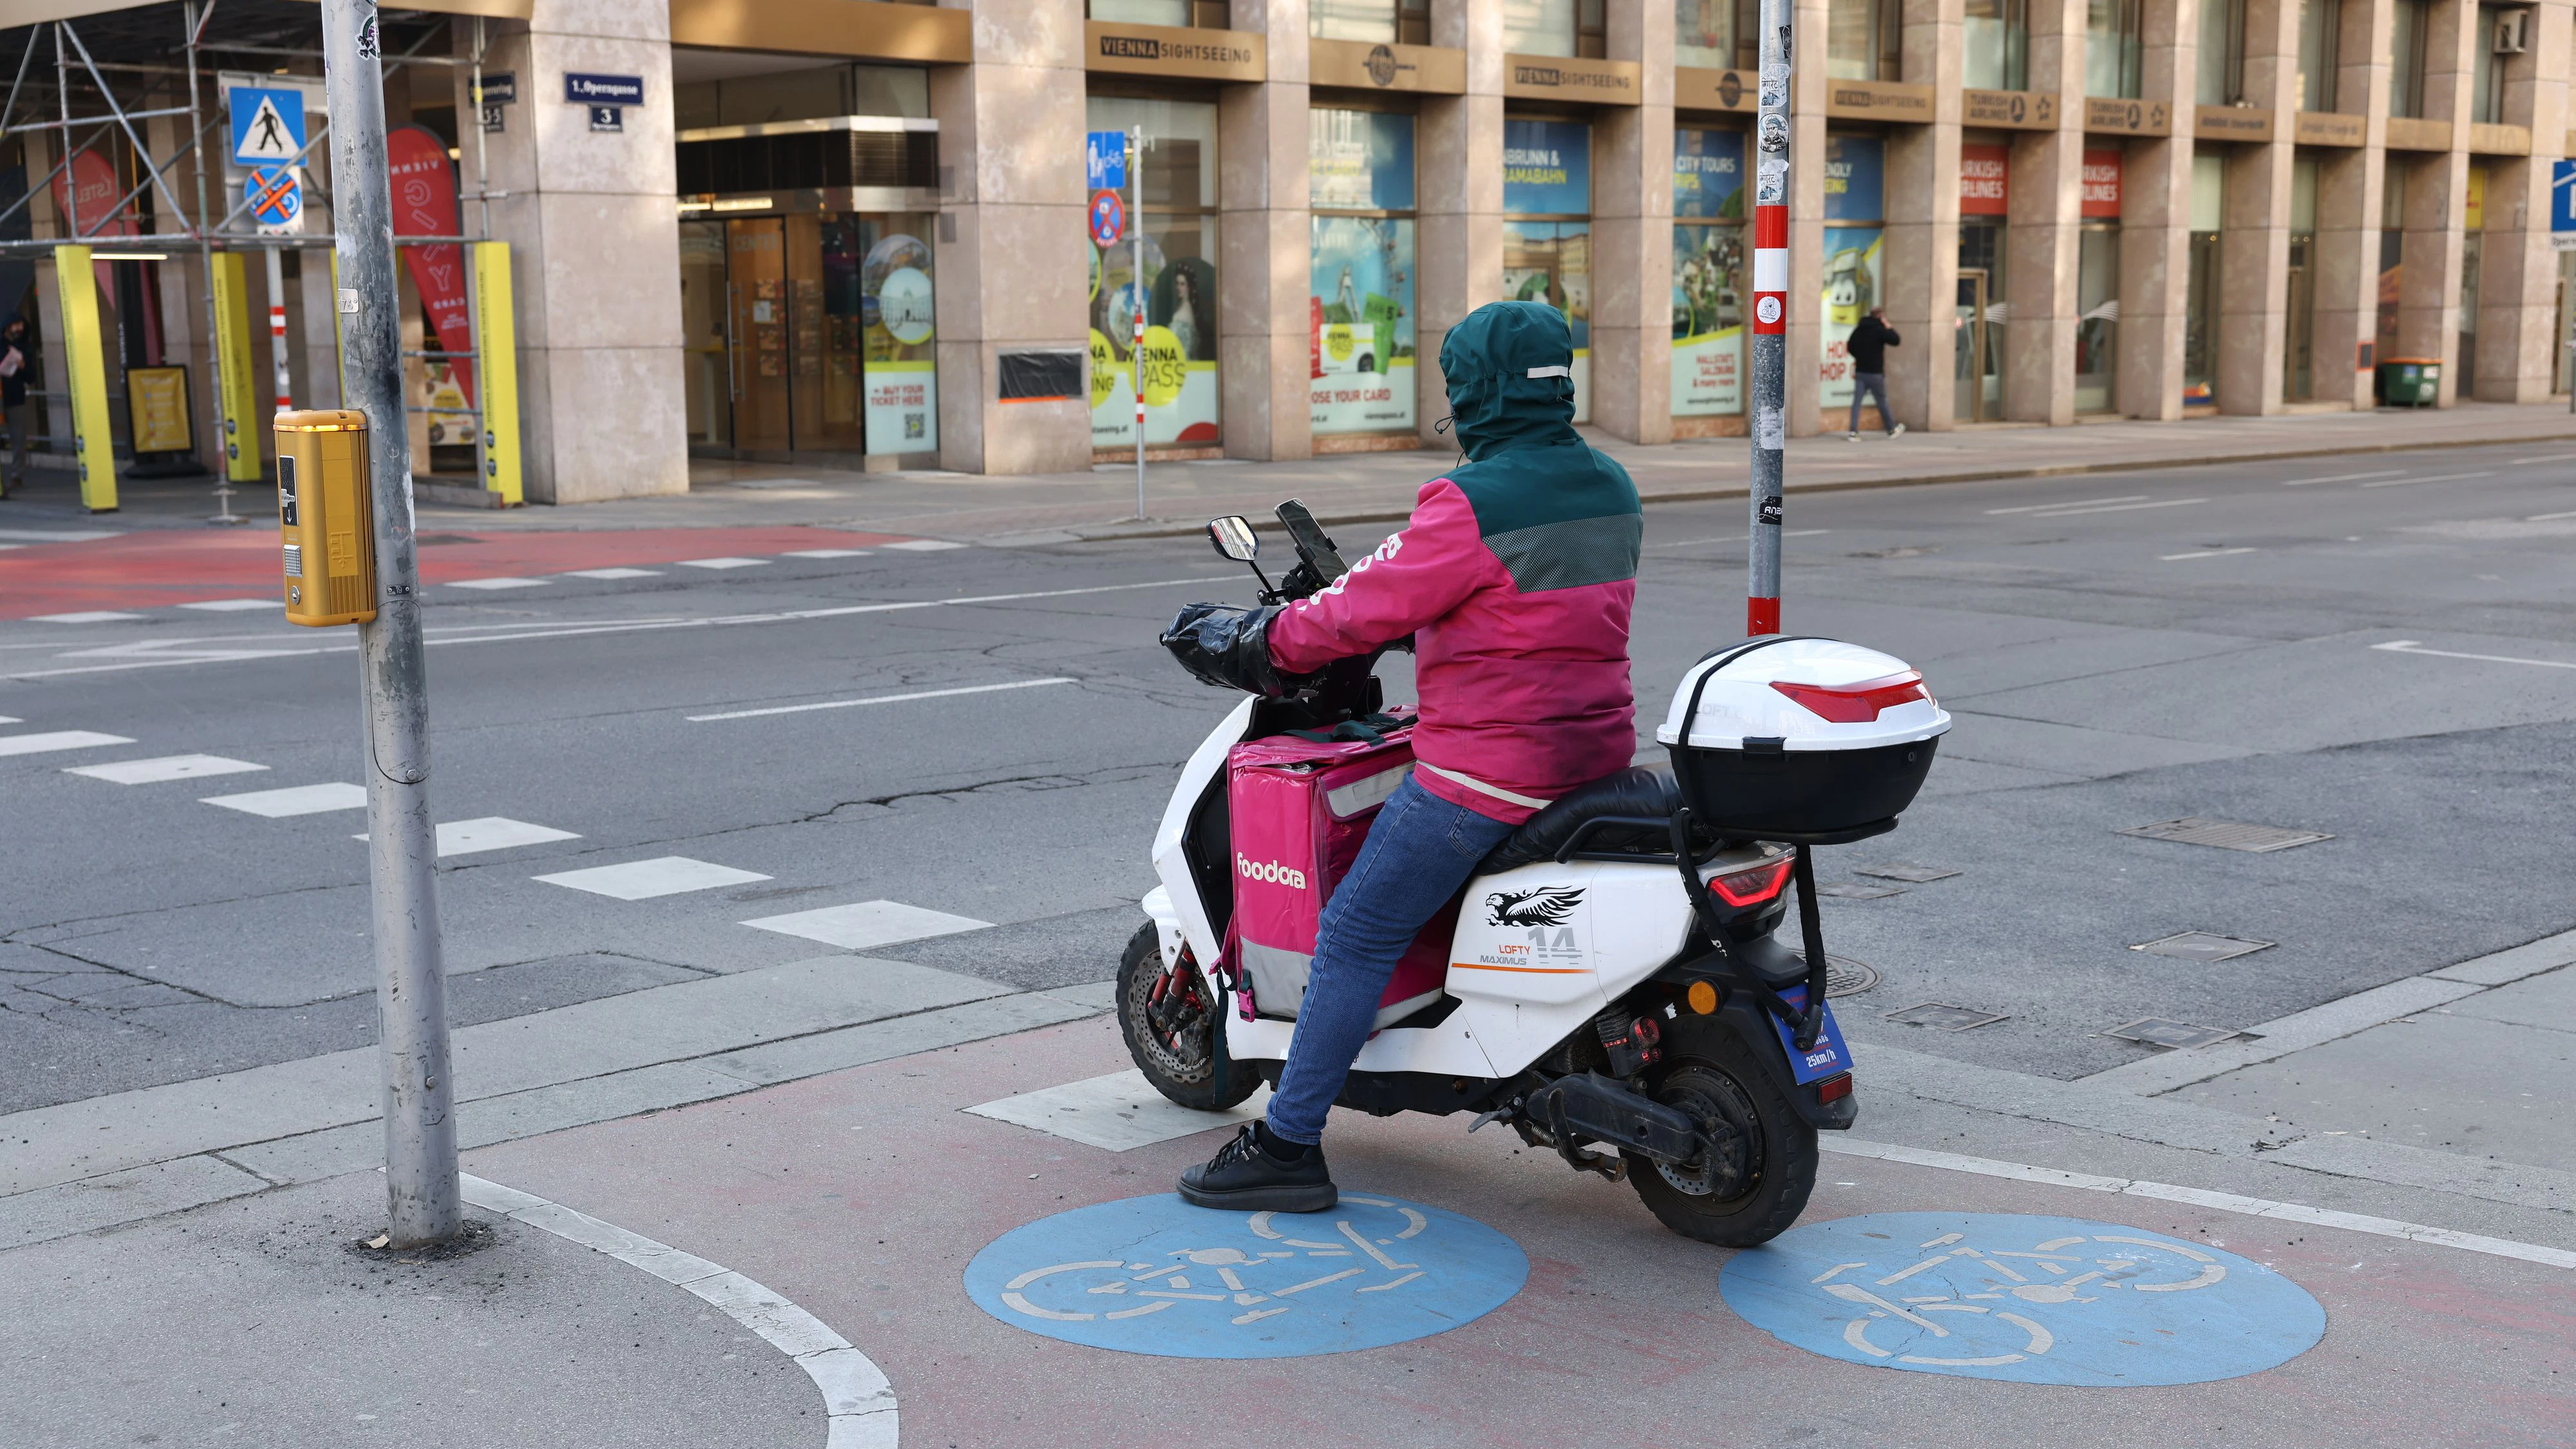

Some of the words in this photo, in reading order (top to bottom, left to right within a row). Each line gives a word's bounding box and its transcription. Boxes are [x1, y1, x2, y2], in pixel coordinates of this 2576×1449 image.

[1101, 37, 1158, 59] VIENNA
[1160, 43, 1251, 63] SIGHTSEEING
[1515, 67, 1558, 86] VIENNA
[1561, 72, 1630, 89] SIGHTSEEING
[583, 80, 638, 96] Operngasse
[1969, 93, 2009, 107] TURKISH
[600, 108, 612, 124] 3
[1969, 107, 2008, 120] AIRLINES
[2090, 102, 2125, 115] TURKISH
[2090, 113, 2125, 128] AIRLINES
[1551, 149, 1560, 167] &
[1676, 156, 1701, 171] CITY
[1702, 157, 1736, 173] TOURS
[1126, 347, 1178, 362] VENNA
[1826, 341, 1848, 358] HO
[1819, 363, 1845, 381] HOP
[883, 386, 900, 395] BUY
[903, 384, 924, 393] YOUR
[1334, 389, 1361, 402] YOUR
[1363, 388, 1391, 401] CARD
[871, 395, 900, 406] TICKET
[902, 394, 925, 406] HERE
[1296, 533, 1403, 612] odora
[1237, 851, 1306, 889] foodora
[1499, 945, 1530, 955] LOFTY
[1528, 927, 1583, 965] 14
[1480, 955, 1527, 966] MAXIMUS
[1806, 1048, 1836, 1068] 25km/h
